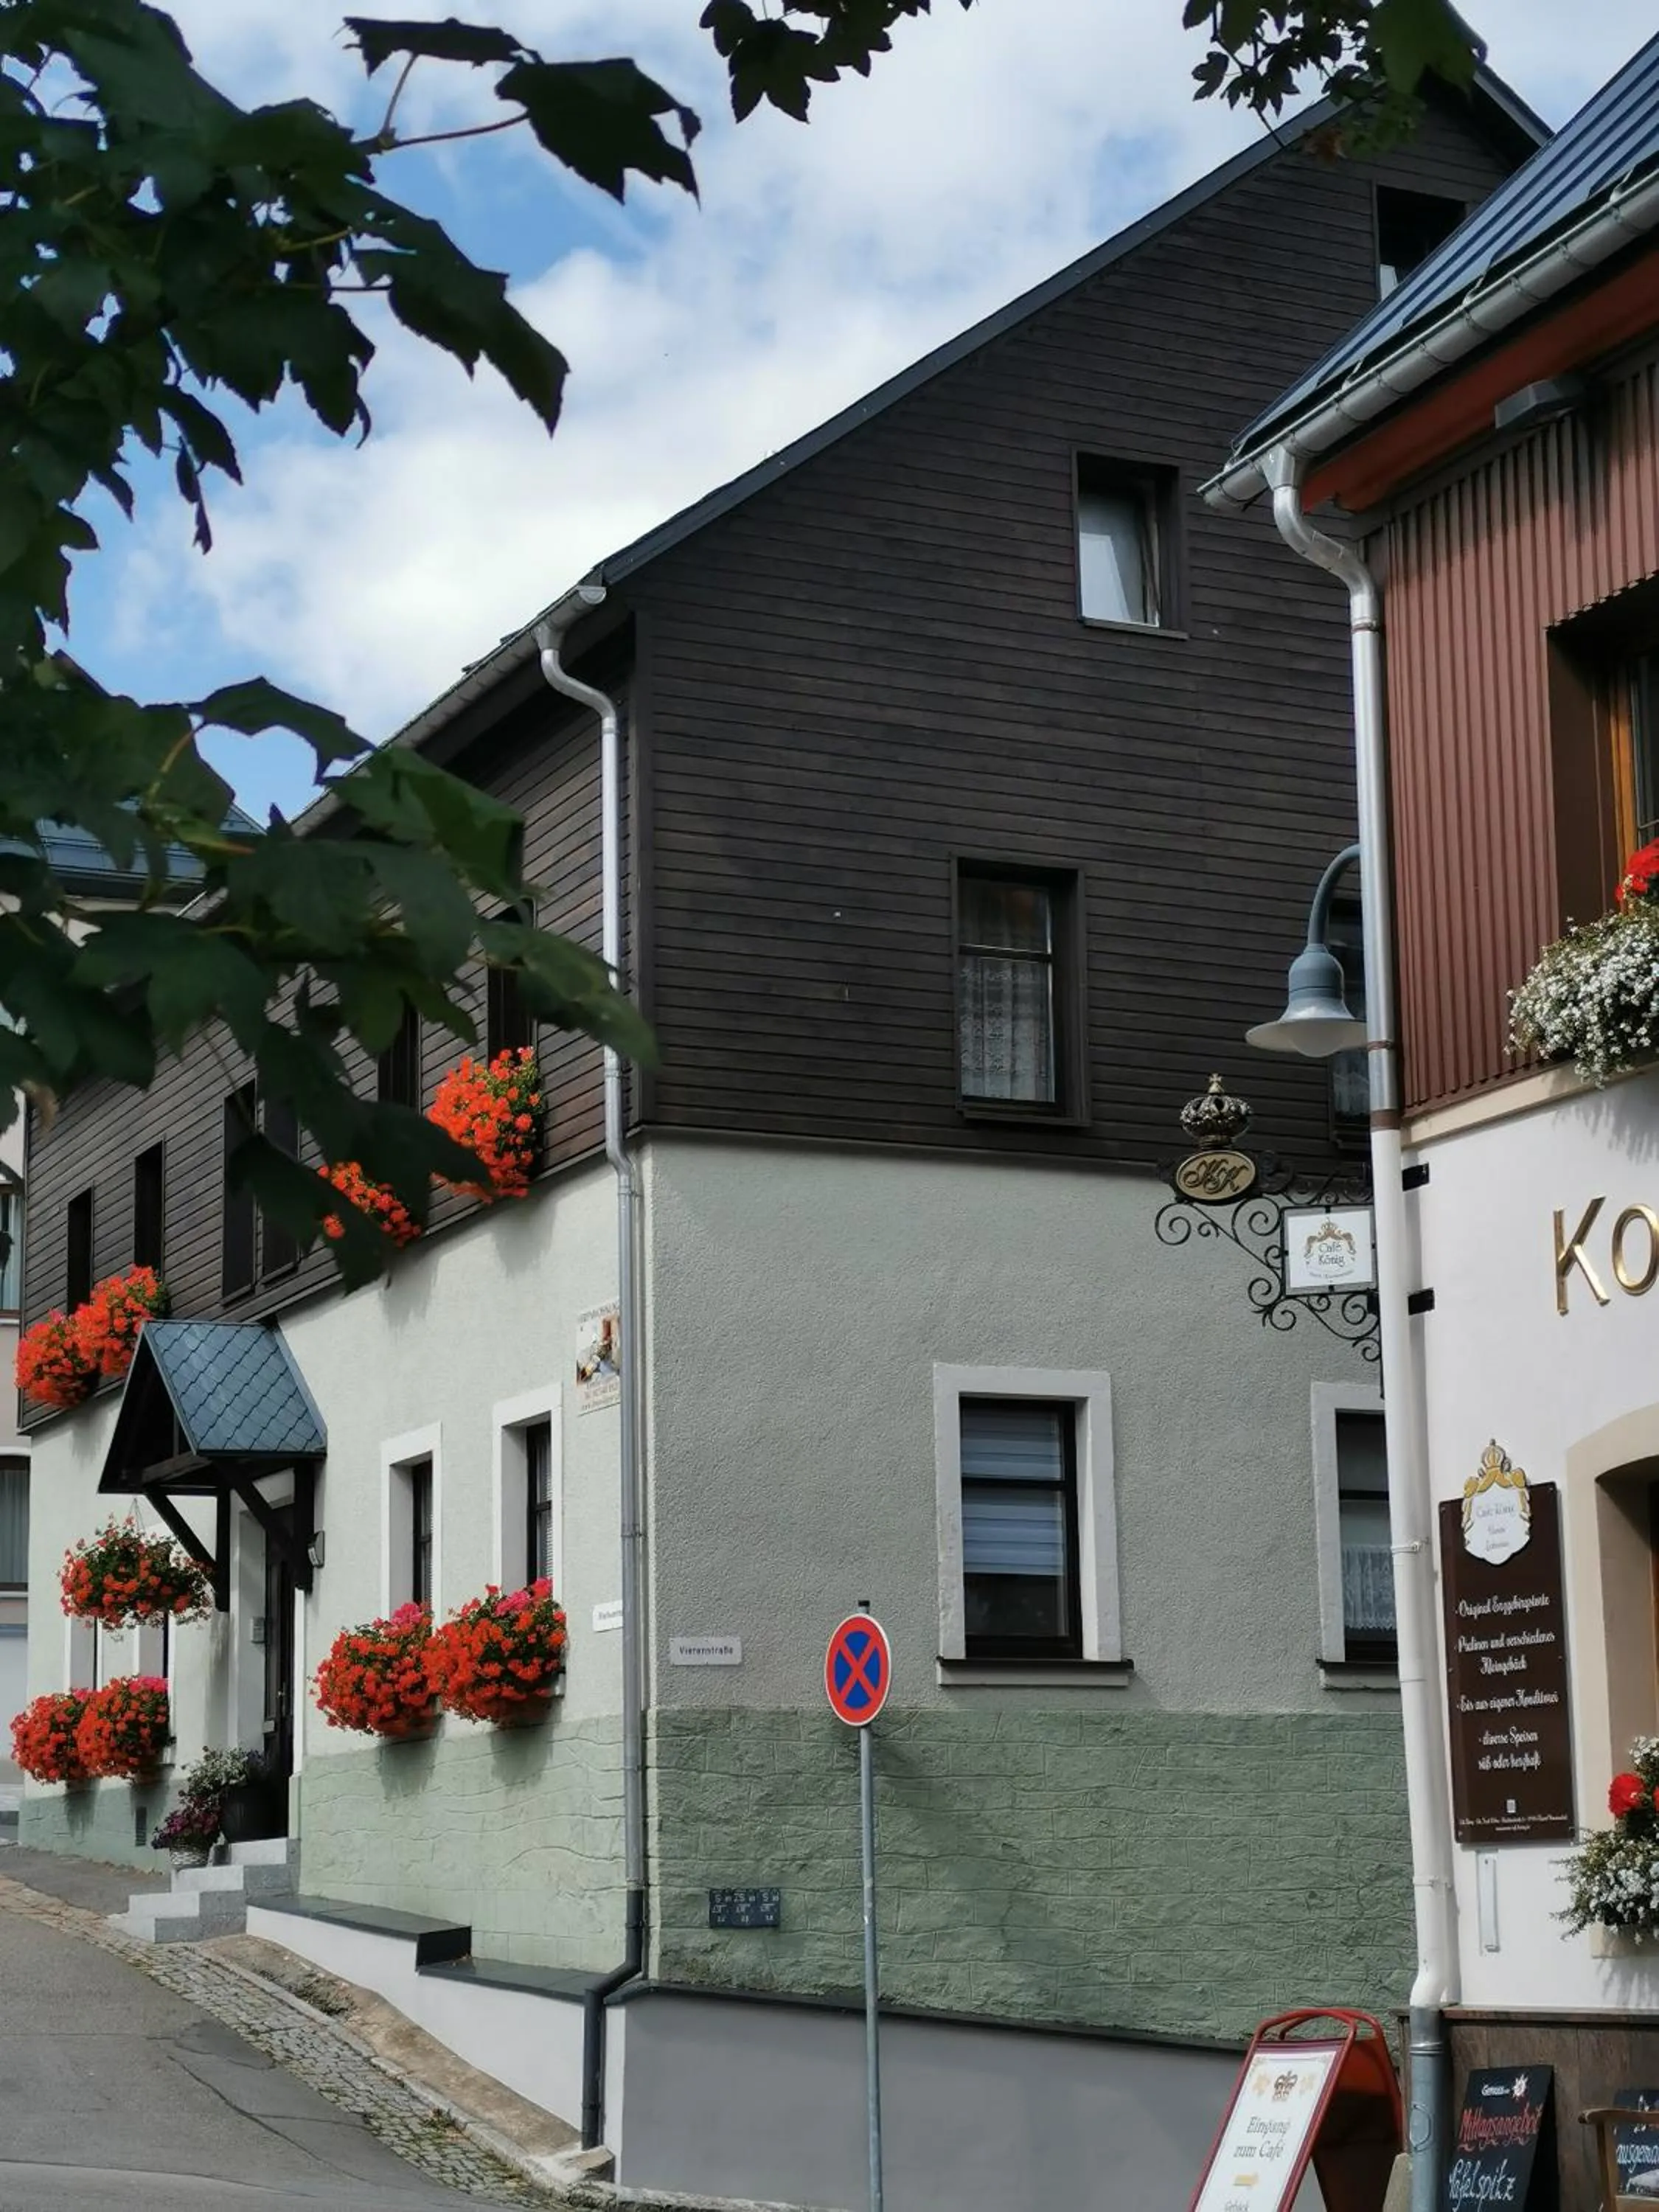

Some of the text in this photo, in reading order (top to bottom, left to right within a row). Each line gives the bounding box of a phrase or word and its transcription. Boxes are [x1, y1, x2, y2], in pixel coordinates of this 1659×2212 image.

[1319, 1241, 1342, 1253] Café
[1318, 1254, 1345, 1267] König
[1458, 1598, 1492, 1620] Original
[1490, 1632, 1505, 1649] und
[1492, 1753, 1510, 1769] oder
[1246, 2115, 1290, 2138] Eingang
[1233, 2140, 1286, 2162] zum Café
